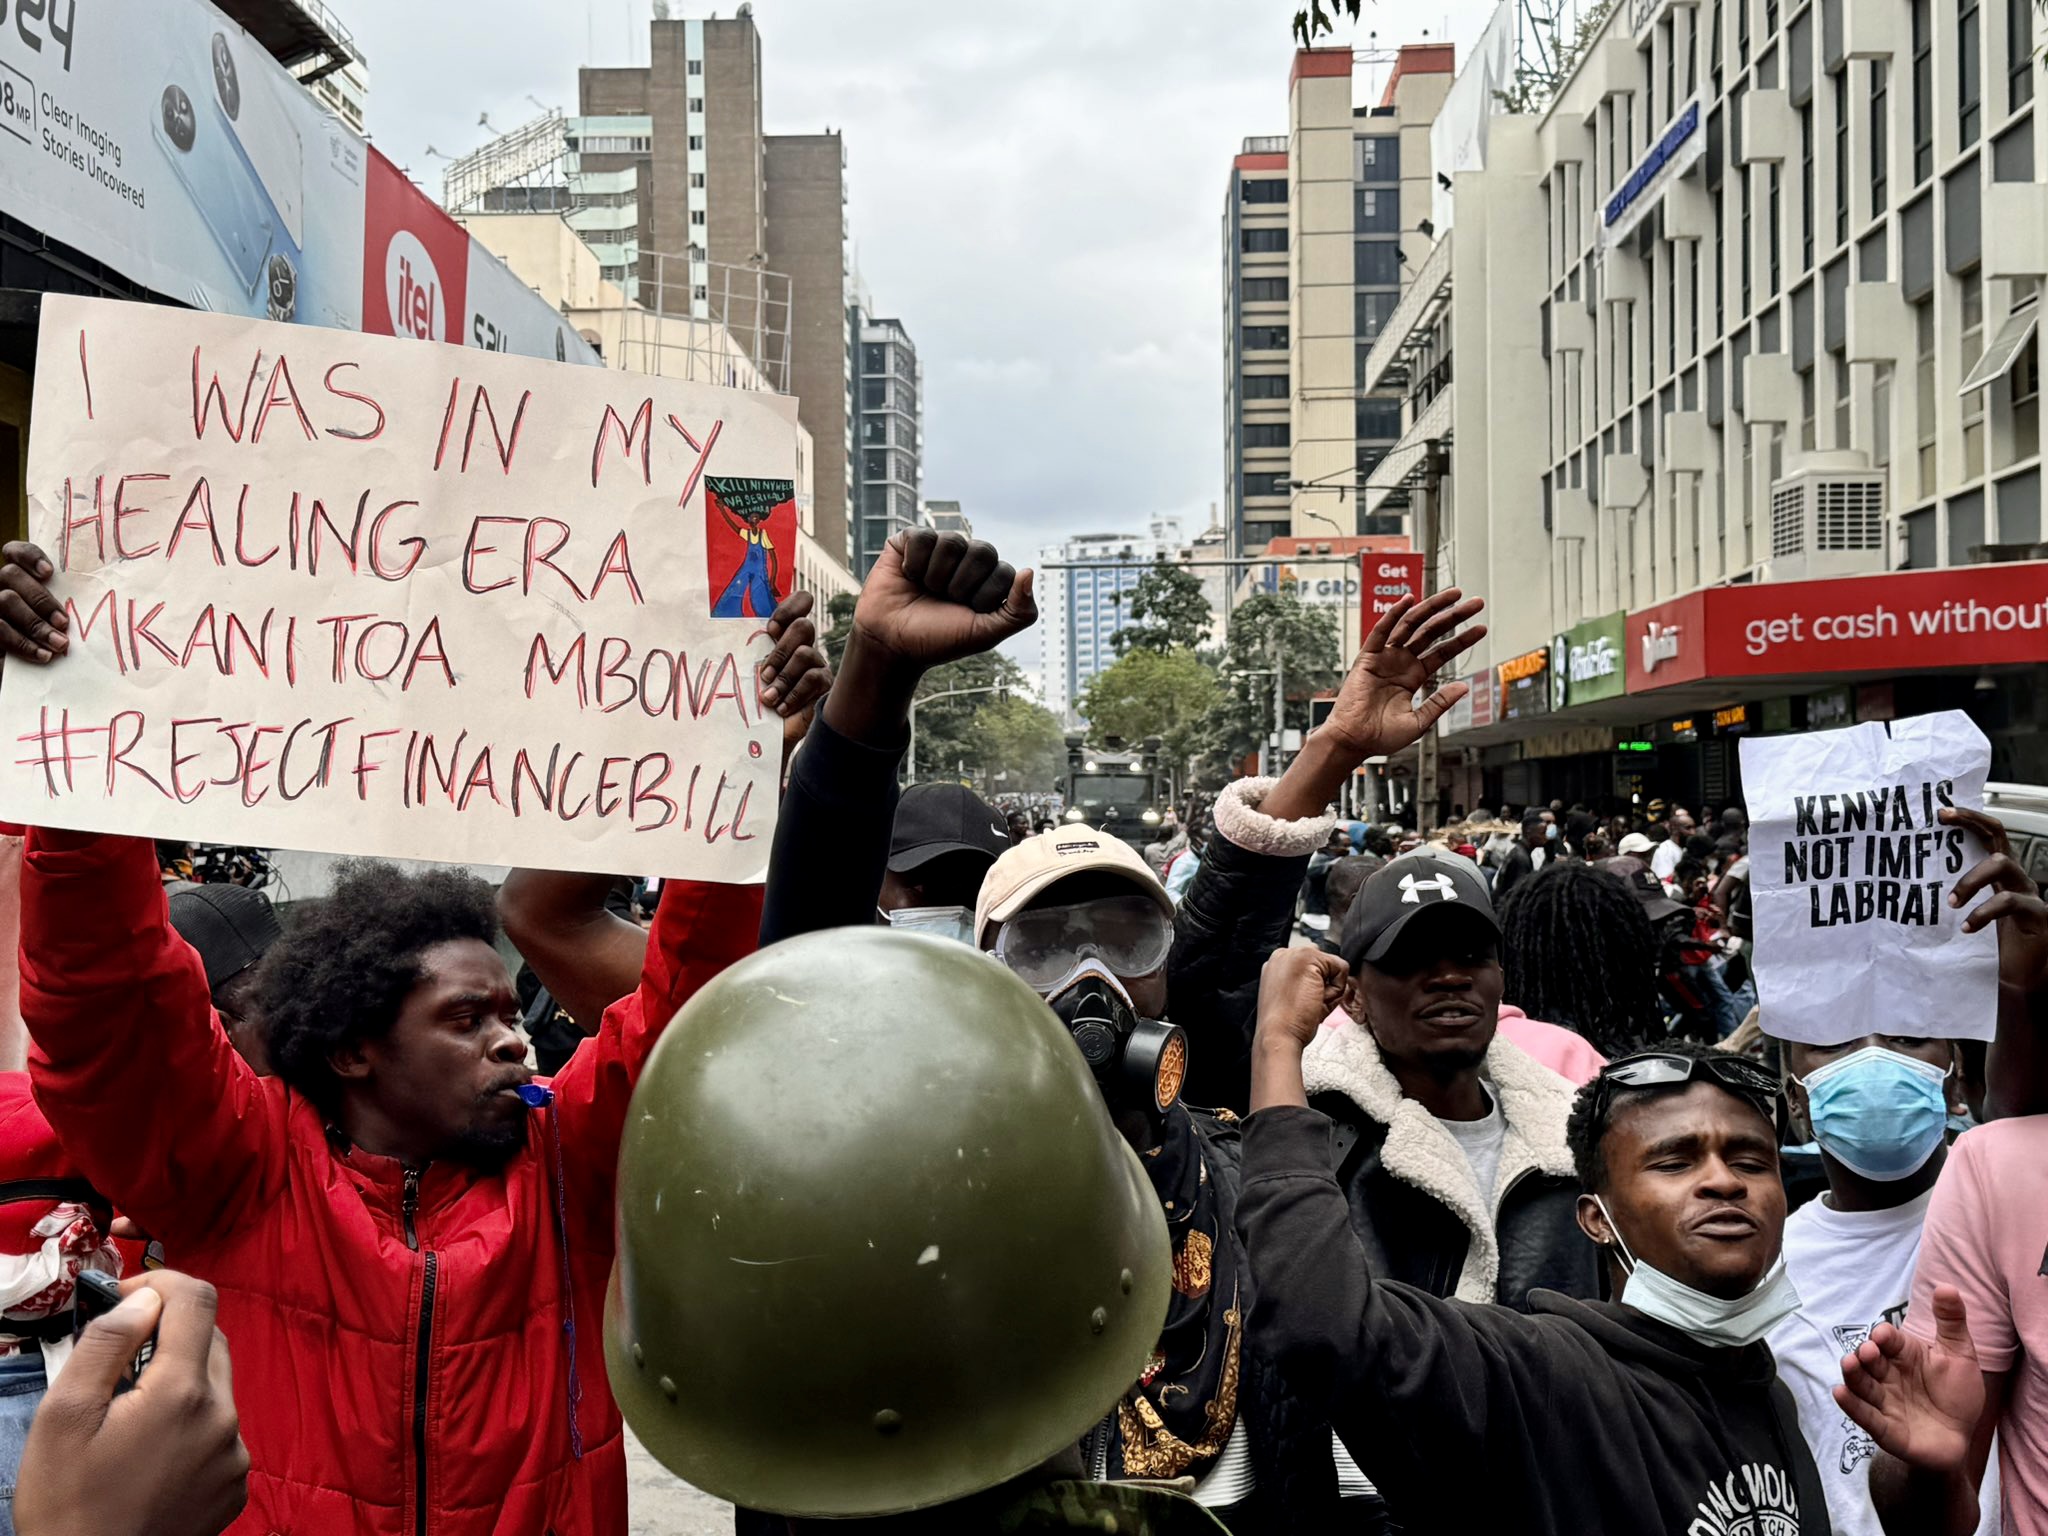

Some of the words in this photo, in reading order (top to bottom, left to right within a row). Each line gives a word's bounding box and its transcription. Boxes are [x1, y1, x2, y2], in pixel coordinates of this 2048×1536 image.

[41, 92, 73, 130] Clear
[76, 113, 122, 167] Imaging
[42, 127, 85, 172] Stories
[87, 153, 145, 209] Uncovered
[399, 255, 437, 341] itel
[79, 329, 94, 420] I
[191, 344, 386, 444] WAS
[433, 377, 532, 476] IN
[590, 397, 723, 509] MY
[705, 478, 748, 493] AKILI
[724, 495, 744, 507] NA
[60, 472, 427, 582] HEALING
[462, 515, 645, 605] ERA
[1373, 582, 1413, 596] cash
[1378, 563, 1409, 579] Get
[1745, 612, 1804, 656] get
[1812, 604, 1898, 641] cash
[1793, 784, 1914, 837] KENYA
[1922, 779, 1955, 828] IS
[1784, 836, 1855, 885] NOT
[1865, 828, 1965, 881] IMF'S
[1810, 880, 1944, 929] LABRAT
